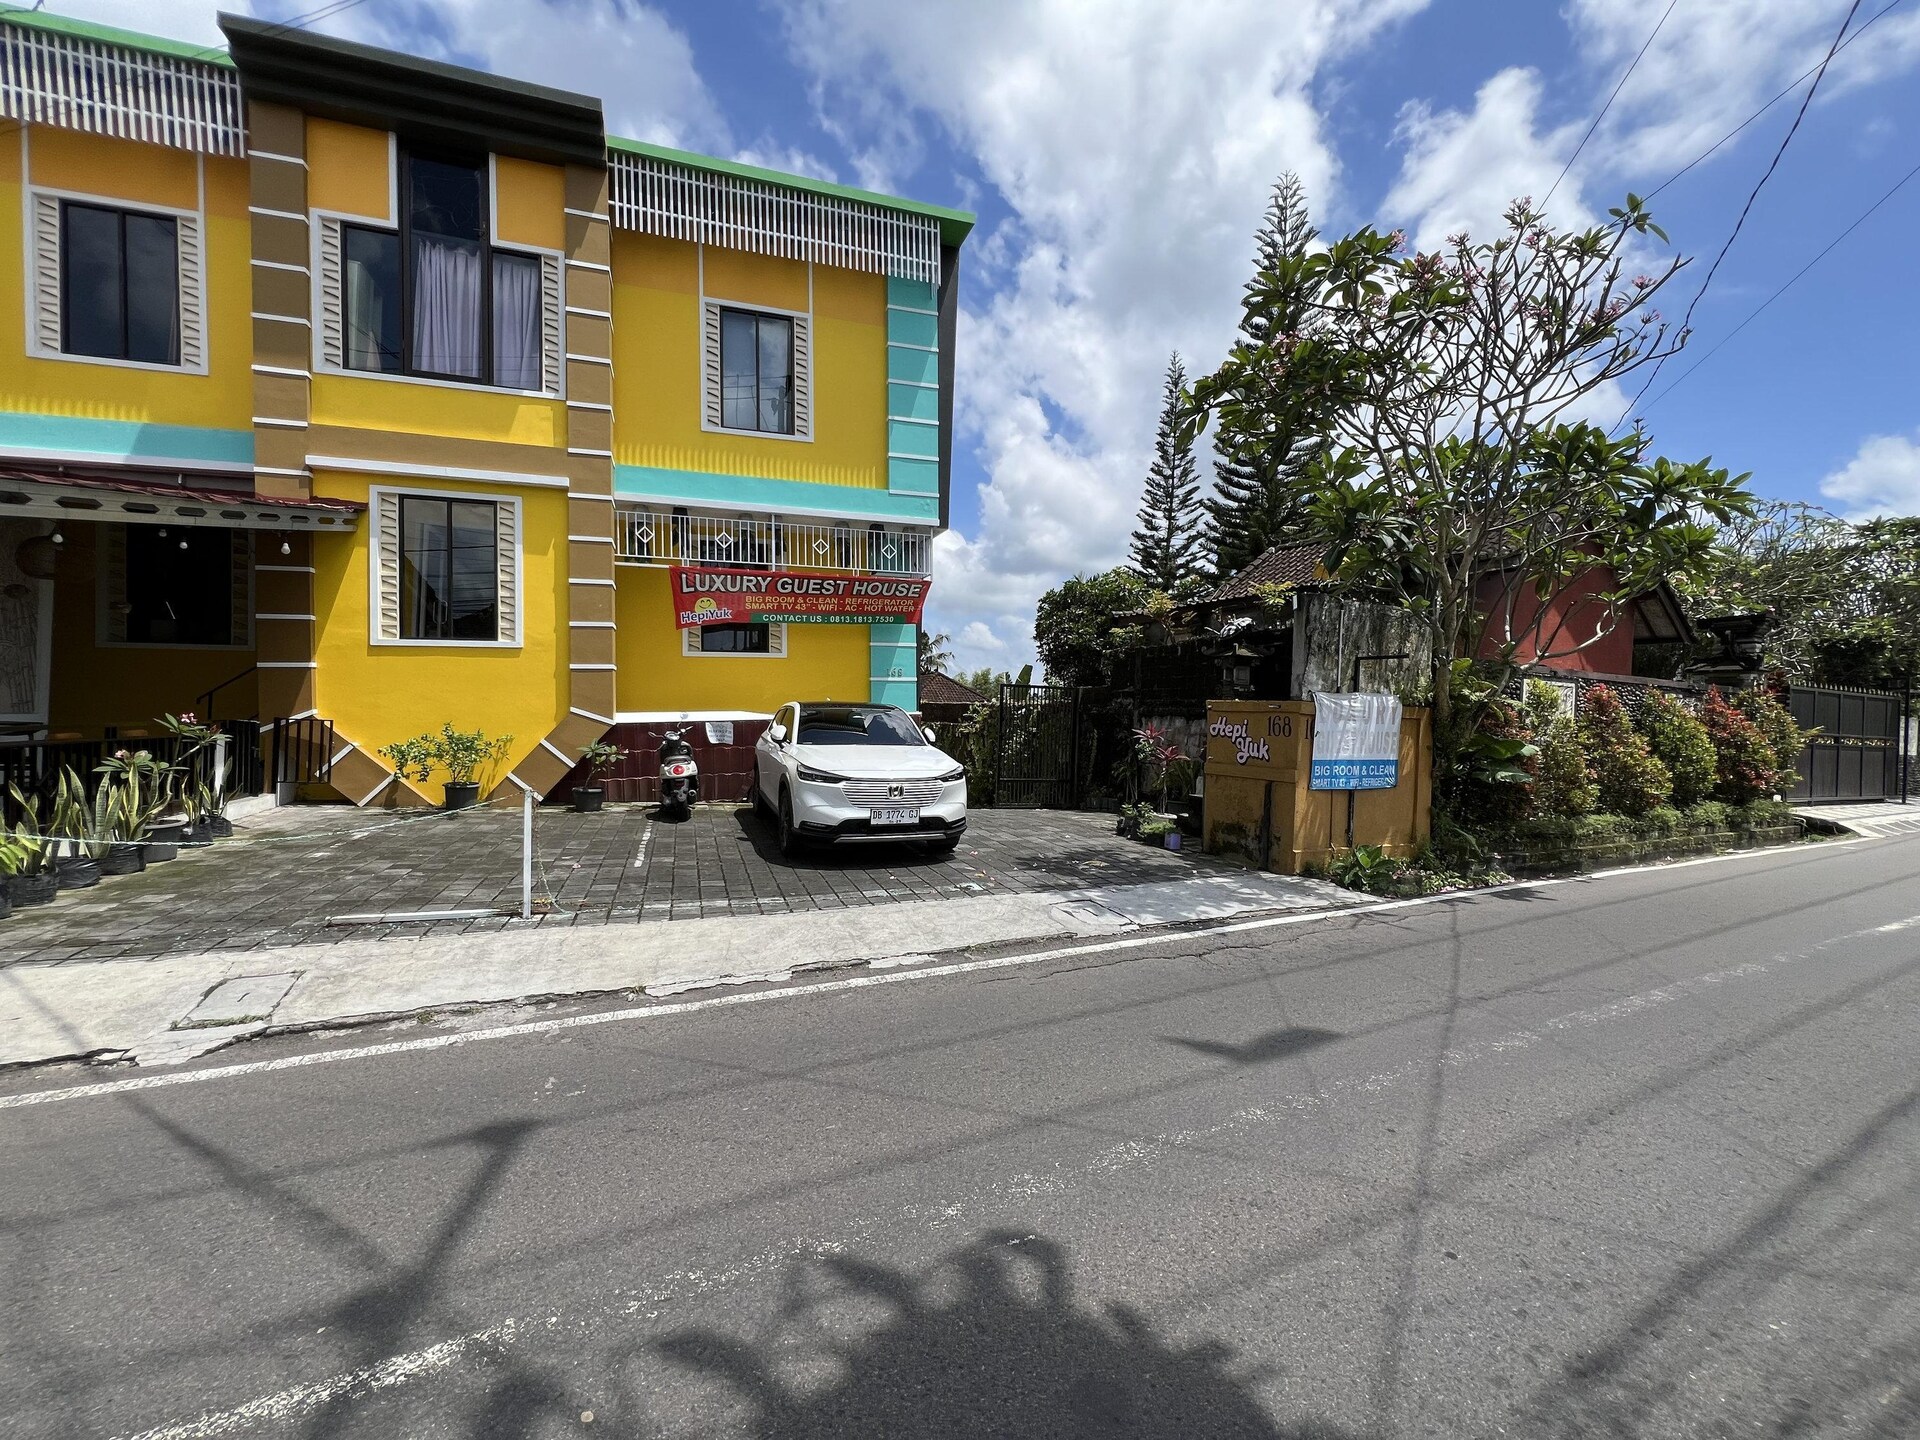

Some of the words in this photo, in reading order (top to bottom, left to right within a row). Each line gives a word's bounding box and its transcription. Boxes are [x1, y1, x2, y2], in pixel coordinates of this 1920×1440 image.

[680, 572, 773, 594] LUXURY
[776, 577, 849, 595] GUEST
[852, 581, 923, 598] HOUSE
[745, 595, 764, 603] BIG
[765, 596, 795, 604] ROOM
[845, 598, 914, 606] REFRIGERATOR
[745, 602, 778, 610] SMART
[780, 603, 793, 611] TV
[680, 607, 732, 625] HepiYuk
[762, 614, 808, 622] CONTACT
[810, 615, 822, 623] US
[1209, 716, 1248, 743] Hepi
[1267, 716, 1292, 738] 168
[1235, 737, 1271, 764] Yuk
[1314, 765, 1330, 776] BIG
[1332, 765, 1360, 776] ROOM
[1361, 765, 1367, 776] &
[1369, 765, 1395, 775] CLEAN
[1312, 778, 1330, 787] SMART
[886, 809, 905, 820] 1774
